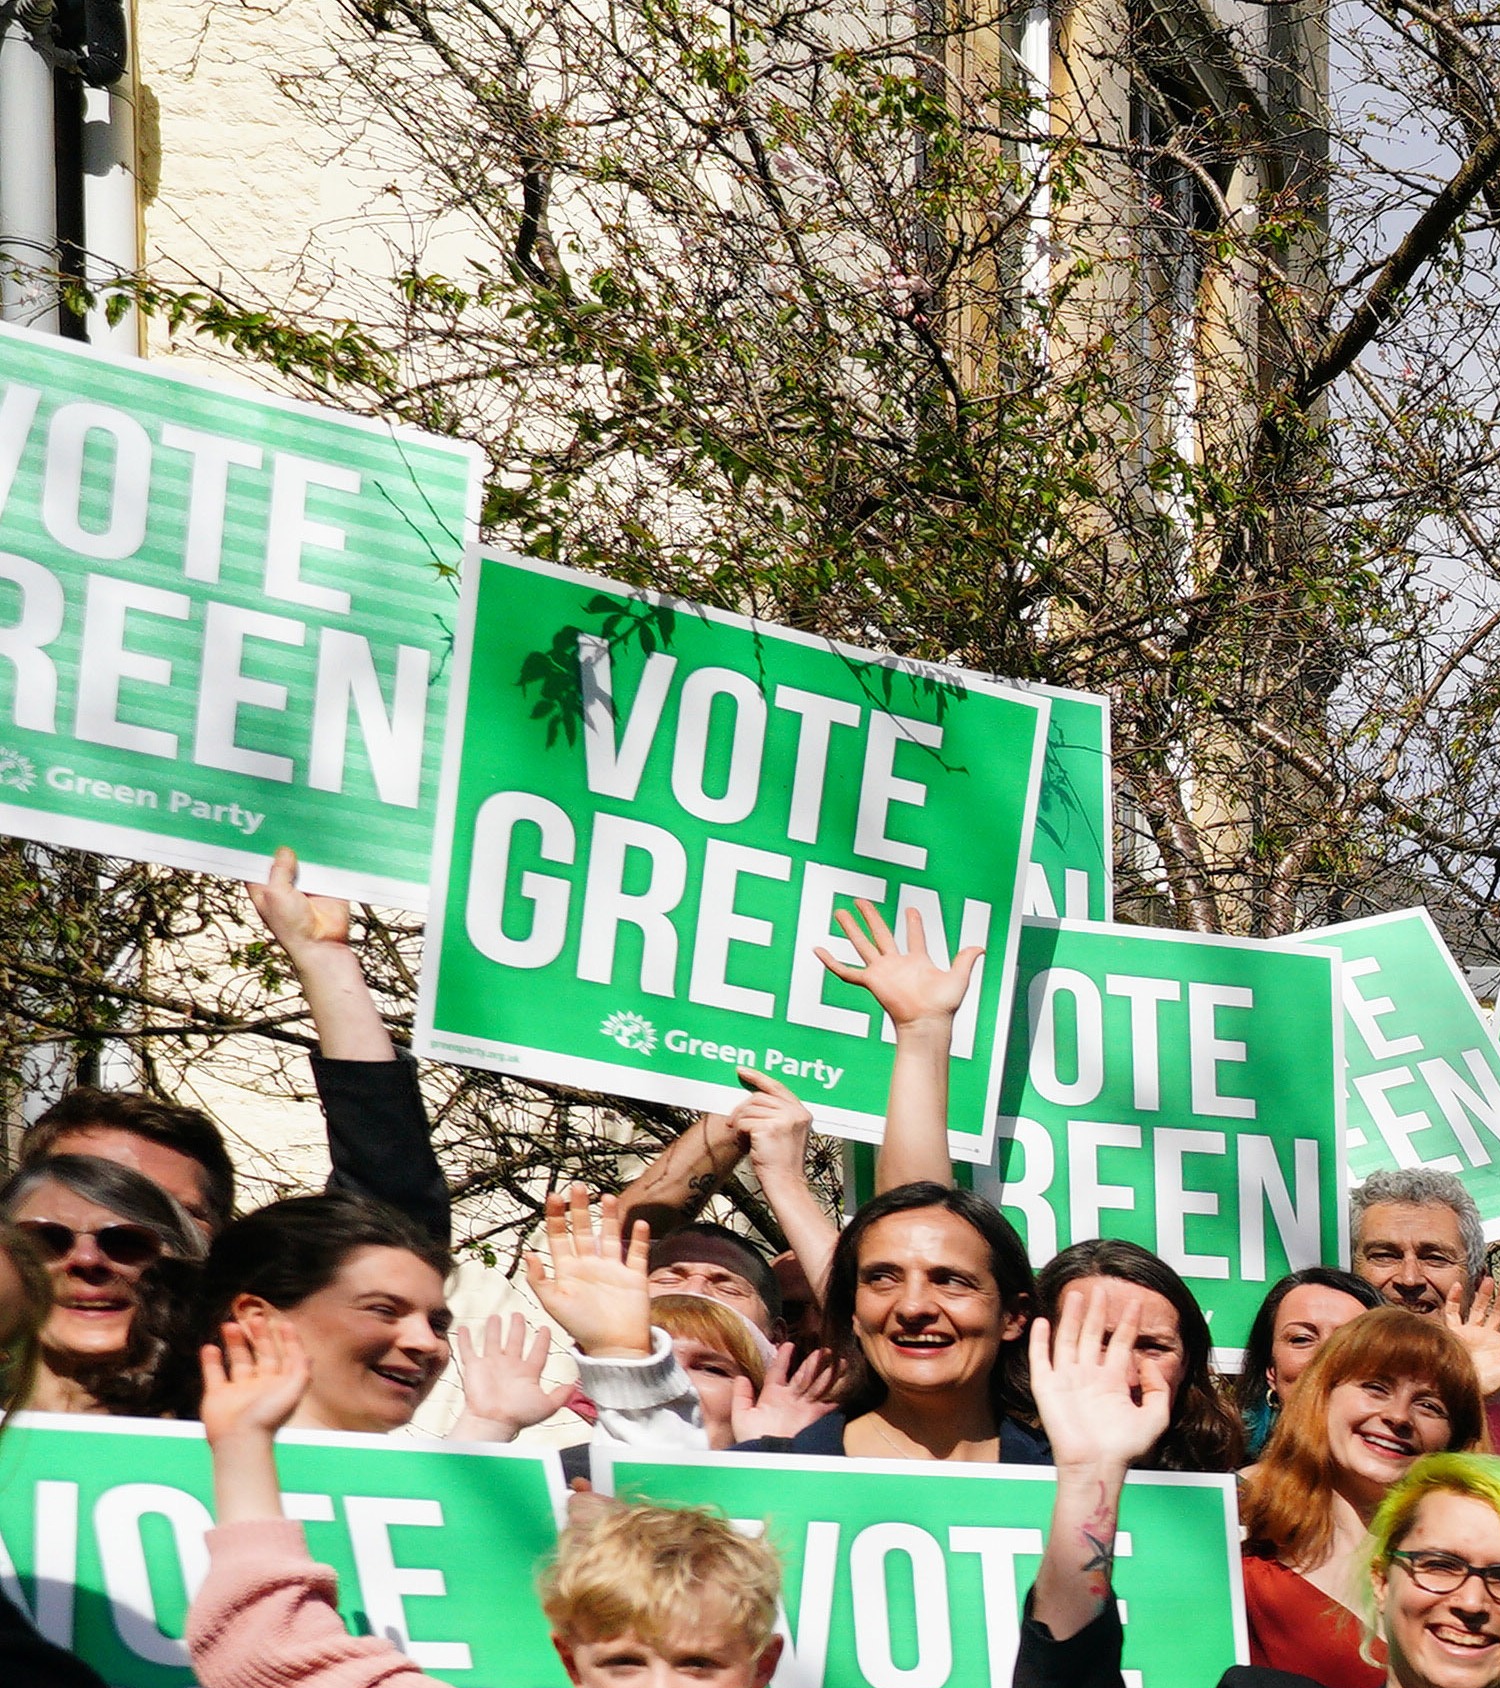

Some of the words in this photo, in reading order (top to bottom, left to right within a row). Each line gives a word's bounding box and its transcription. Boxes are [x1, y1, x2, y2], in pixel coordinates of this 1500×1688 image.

[0, 560, 432, 808] REEN
[576, 632, 943, 872] VOTE
[46, 766, 158, 808] Green
[168, 790, 266, 834] Party
[465, 790, 992, 1060] GREEN
[664, 1029, 755, 1069] Green
[764, 1046, 844, 1090] Party
[1027, 967, 1257, 1119] OTE
[991, 1113, 1322, 1281] REEN
